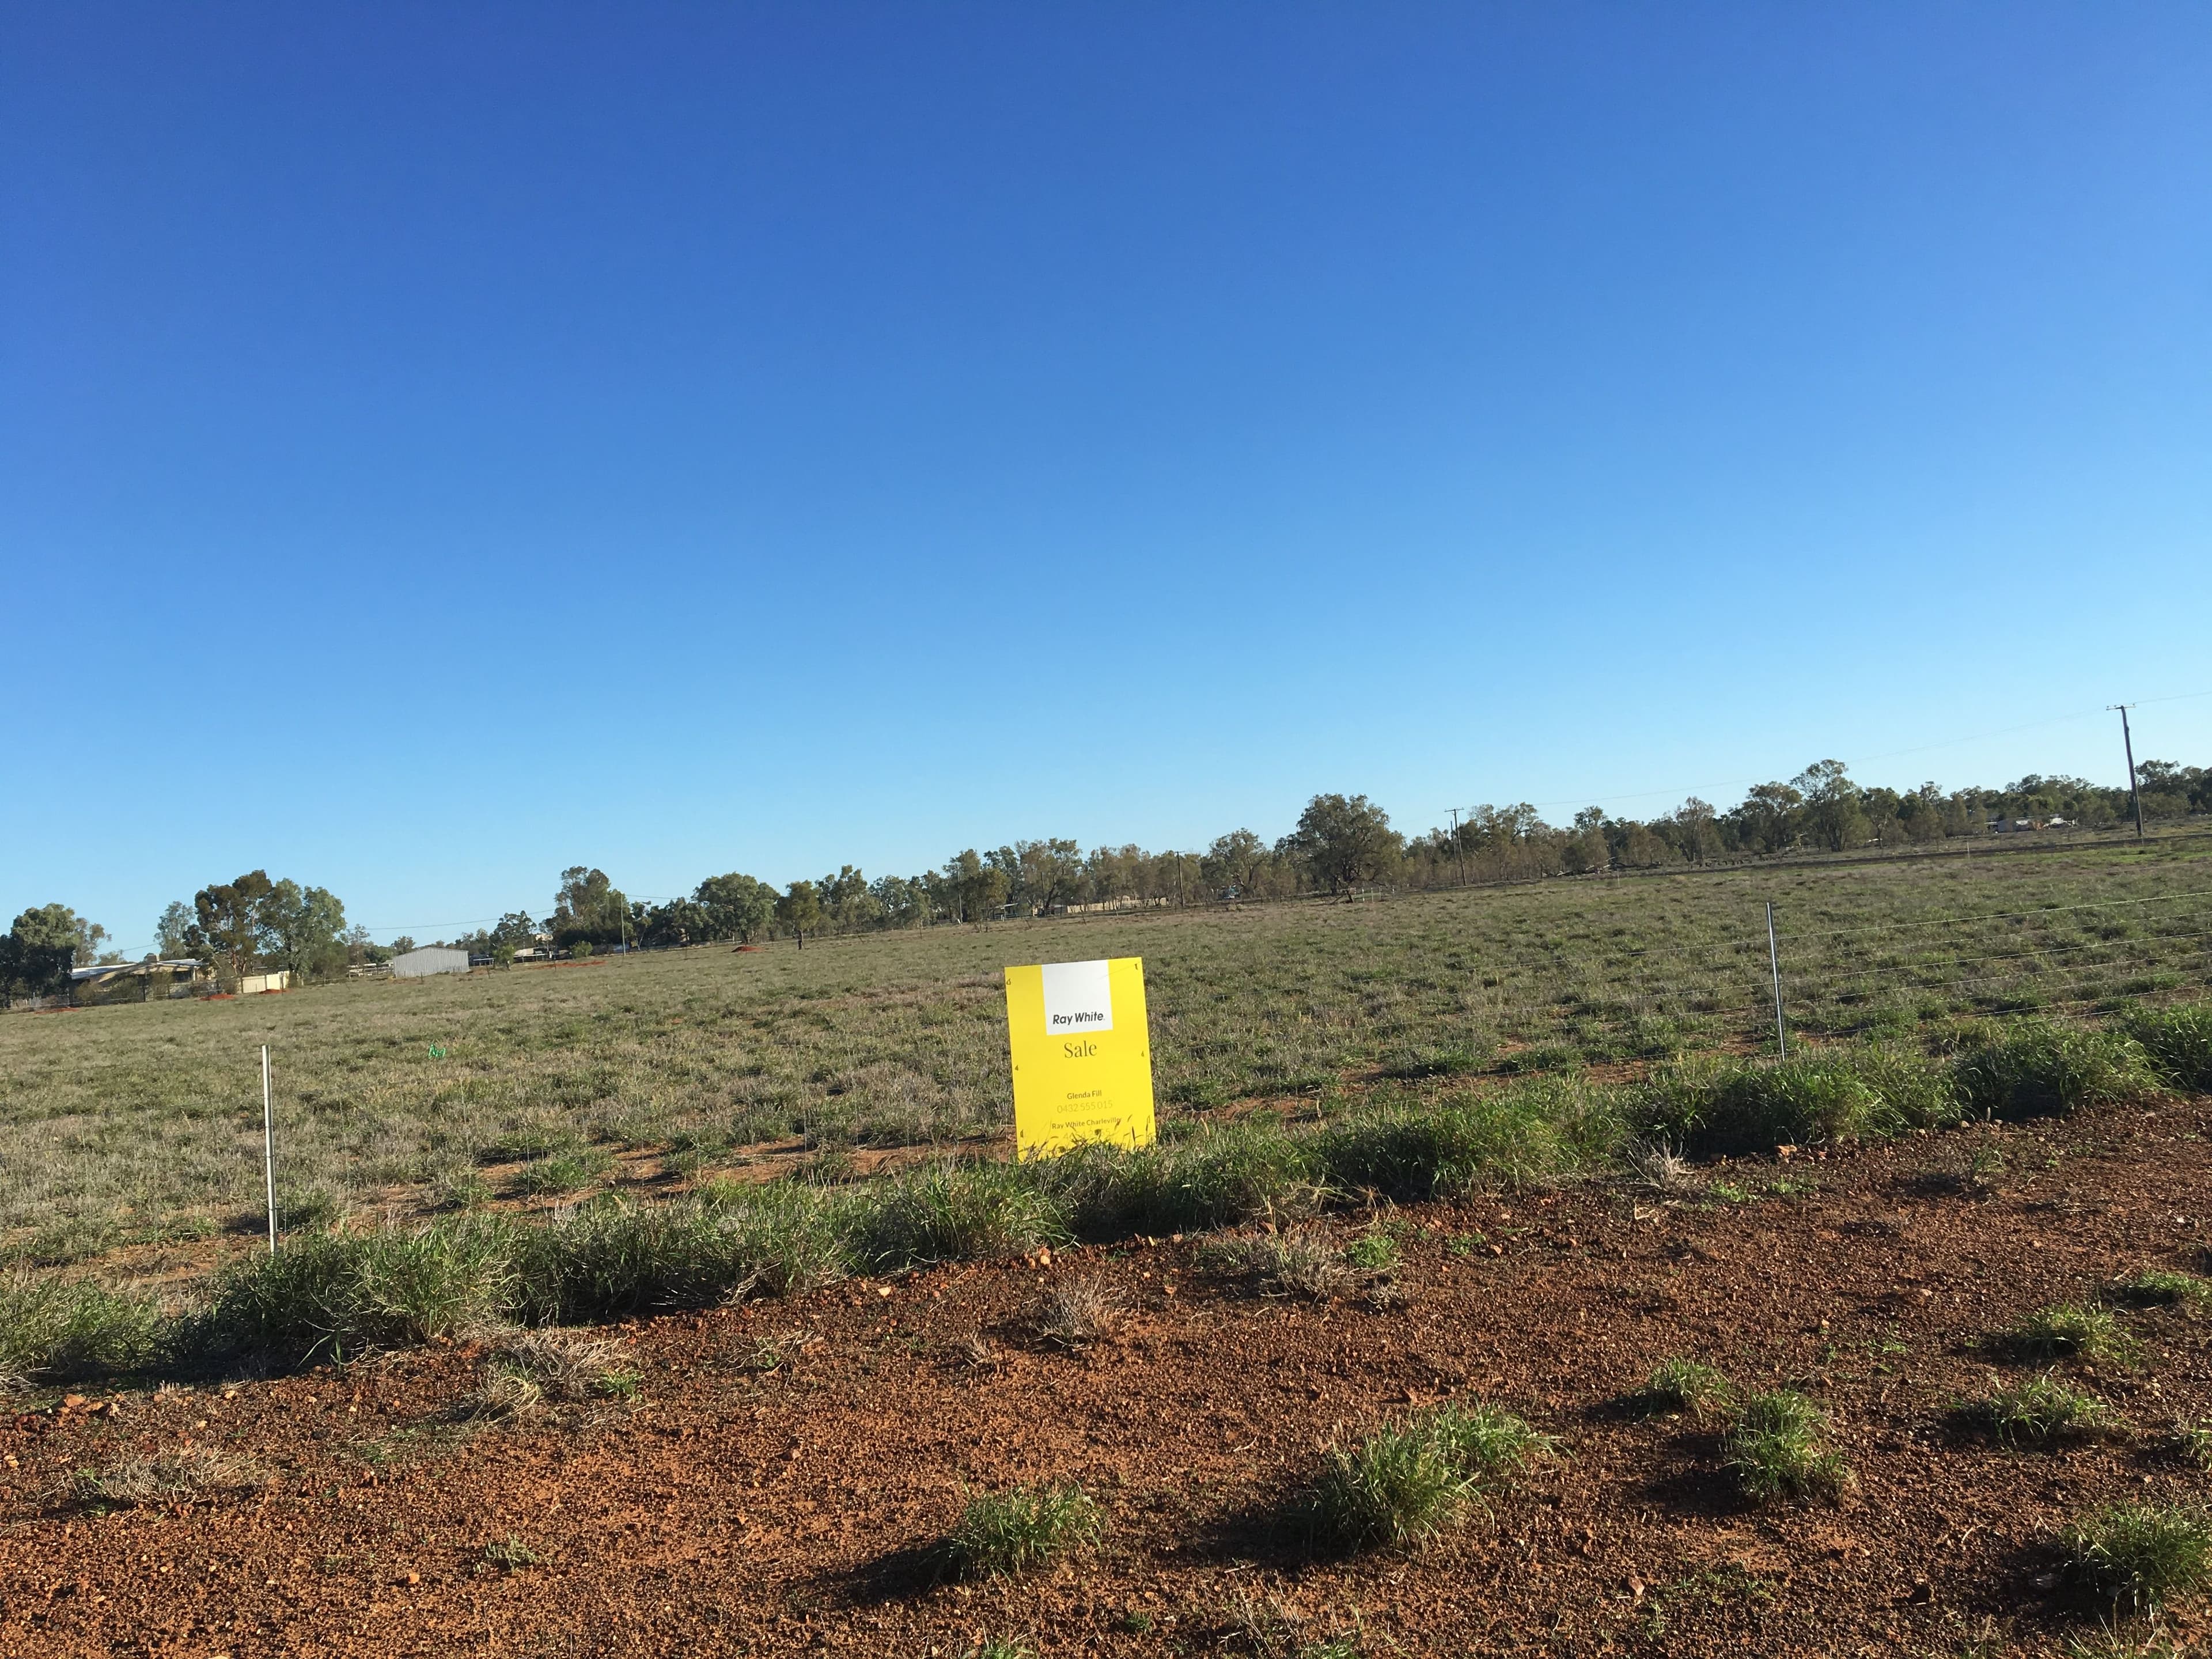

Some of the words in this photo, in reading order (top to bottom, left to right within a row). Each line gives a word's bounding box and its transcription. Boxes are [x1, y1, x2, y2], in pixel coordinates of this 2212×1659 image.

[1053, 1014, 1073, 1025] Ray
[1074, 1011, 1104, 1022] White
[1064, 1040, 1097, 1058] Sale
[1067, 1092, 1090, 1100] Glenda
[1056, 1103, 1079, 1113] 0432
[1080, 1102, 1096, 1111] 555
[1097, 1100, 1113, 1109] 015
